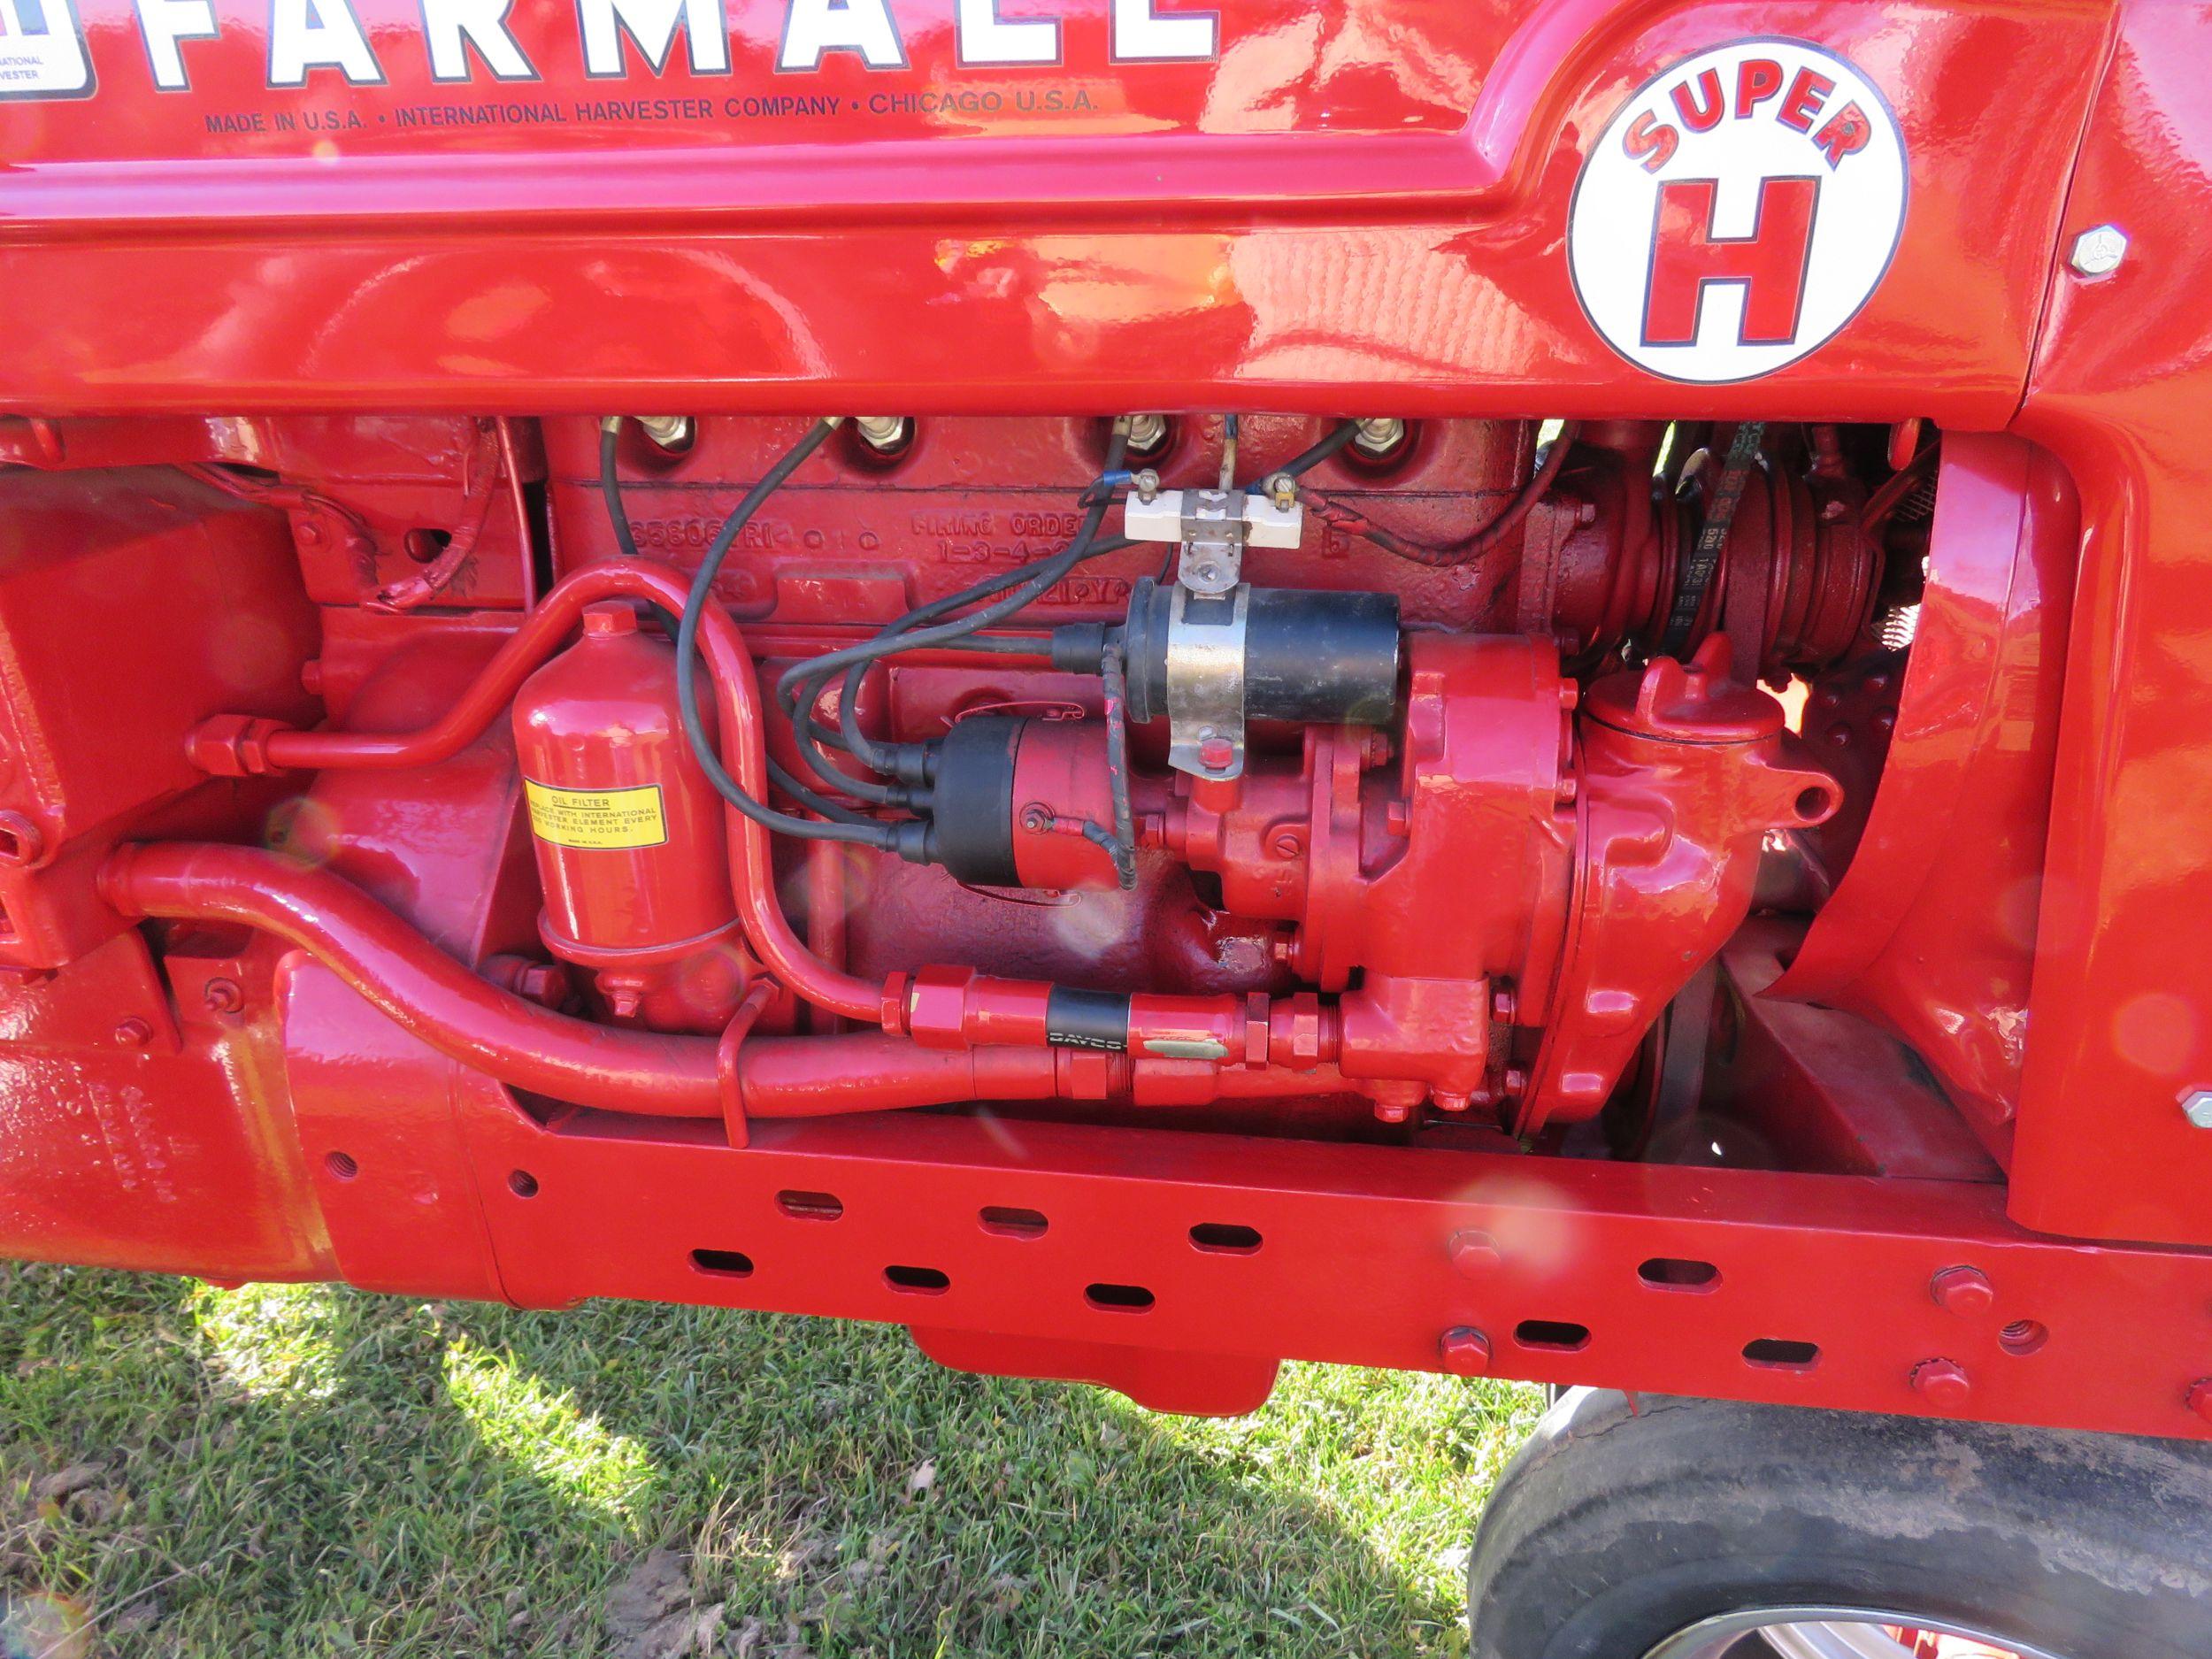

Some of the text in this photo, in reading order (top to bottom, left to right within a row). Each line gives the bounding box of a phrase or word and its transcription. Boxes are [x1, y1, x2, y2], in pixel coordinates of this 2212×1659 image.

[205, 88, 1099, 134] MADE IN U.S.A. INTERNATIONAL HARVESTER COMPANY CHICAGO U.S.A.
[1622, 58, 1872, 175] SUPER
[1640, 175, 1823, 349] H
[551, 795, 611, 807] OIL FILTER
[581, 808, 657, 819] INTERNATIONAL
[624, 814, 657, 825] EVERY
[1048, 1032, 1122, 1050] DAYCO
